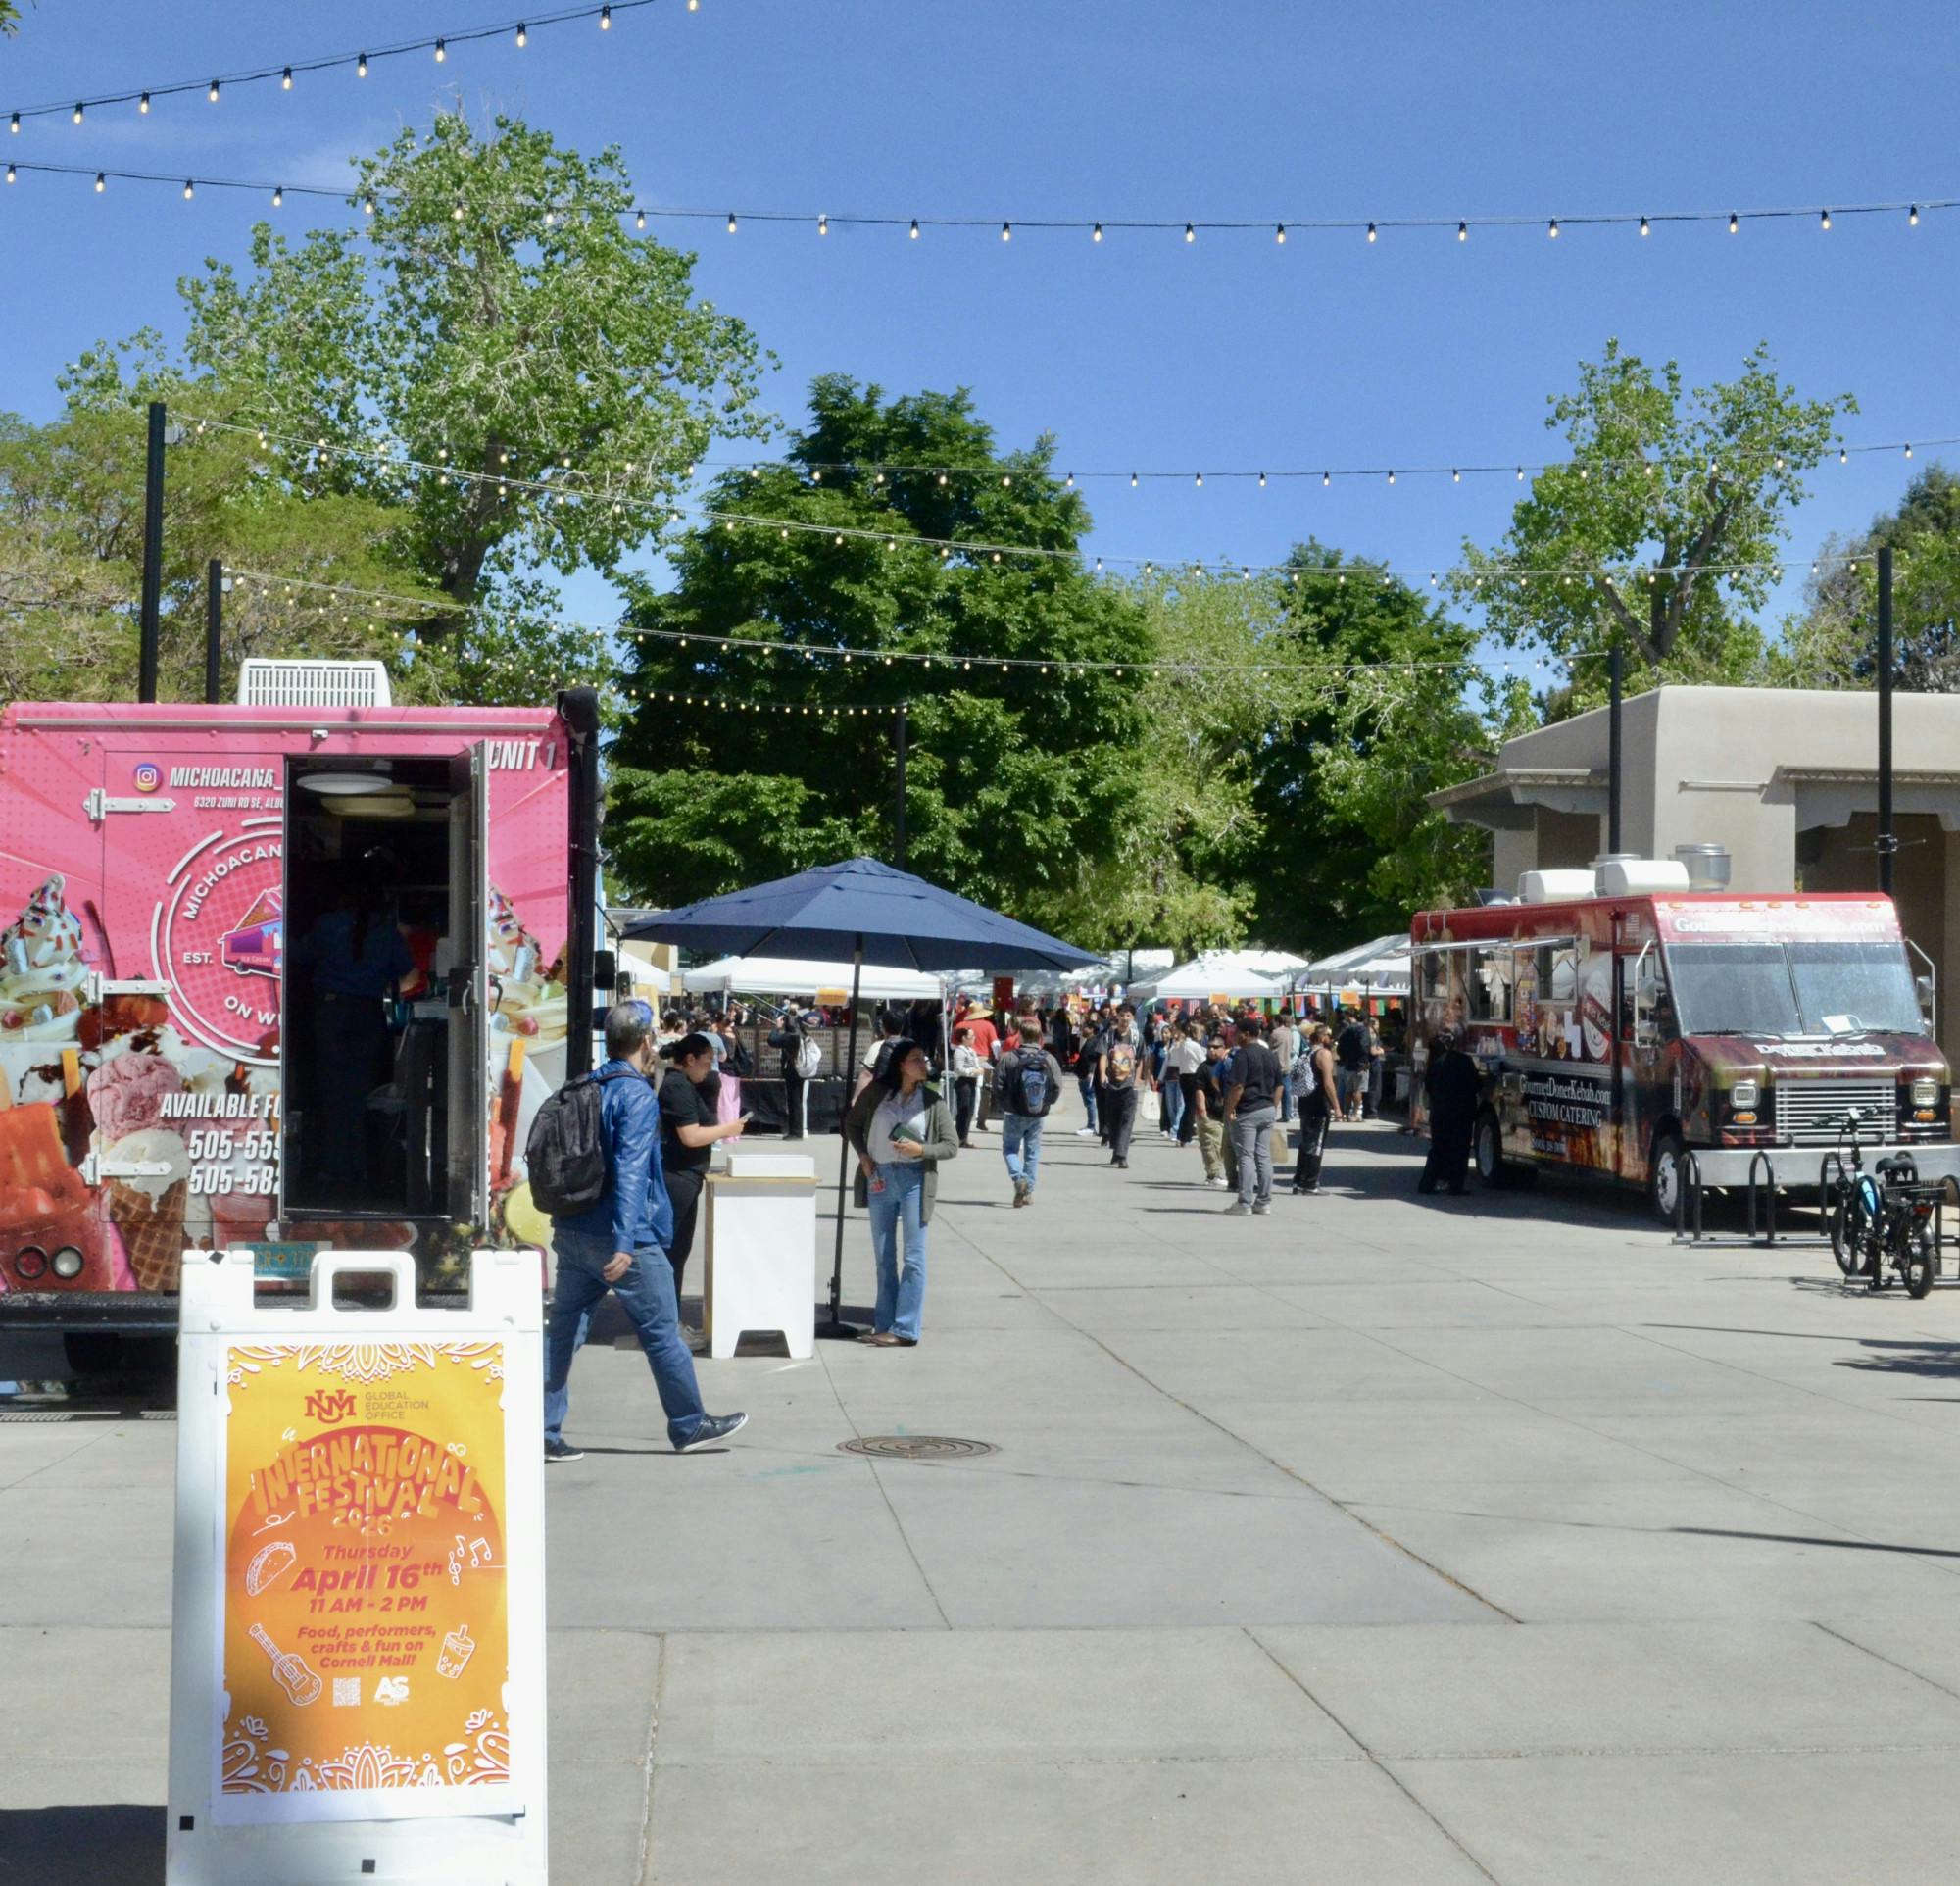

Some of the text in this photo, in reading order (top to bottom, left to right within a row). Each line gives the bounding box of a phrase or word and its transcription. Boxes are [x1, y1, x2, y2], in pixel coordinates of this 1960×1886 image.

[489, 740, 557, 769] UNIT 1
[194, 796, 216, 808] 6320
[217, 796, 236, 808] ZUNI
[238, 796, 250, 808] RD
[182, 952, 213, 964] EST.
[224, 995, 281, 1026] ON W
[160, 1093, 259, 1117] AVAILABLE
[1529, 1100, 1601, 1128] CUSTOM CATERING
[365, 1391, 409, 1401] GLOBAL
[365, 1400, 429, 1410] EDUCATION
[365, 1411, 405, 1420] OFFICE
[252, 1434, 481, 1515] INTERNATIONAL
[297, 1470, 439, 1519] FESTIVAL
[324, 1544, 413, 1561] Thursday
[290, 1563, 444, 1597] April 16th
[310, 1599, 325, 1613] 11
[329, 1597, 363, 1613] AM
[380, 1597, 393, 1613] 2
[397, 1596, 427, 1612] PM
[297, 1625, 436, 1640] Food, performers,
[311, 1639, 423, 1654] crafts & fun on
[319, 1654, 416, 1668] Cornell Mall!
